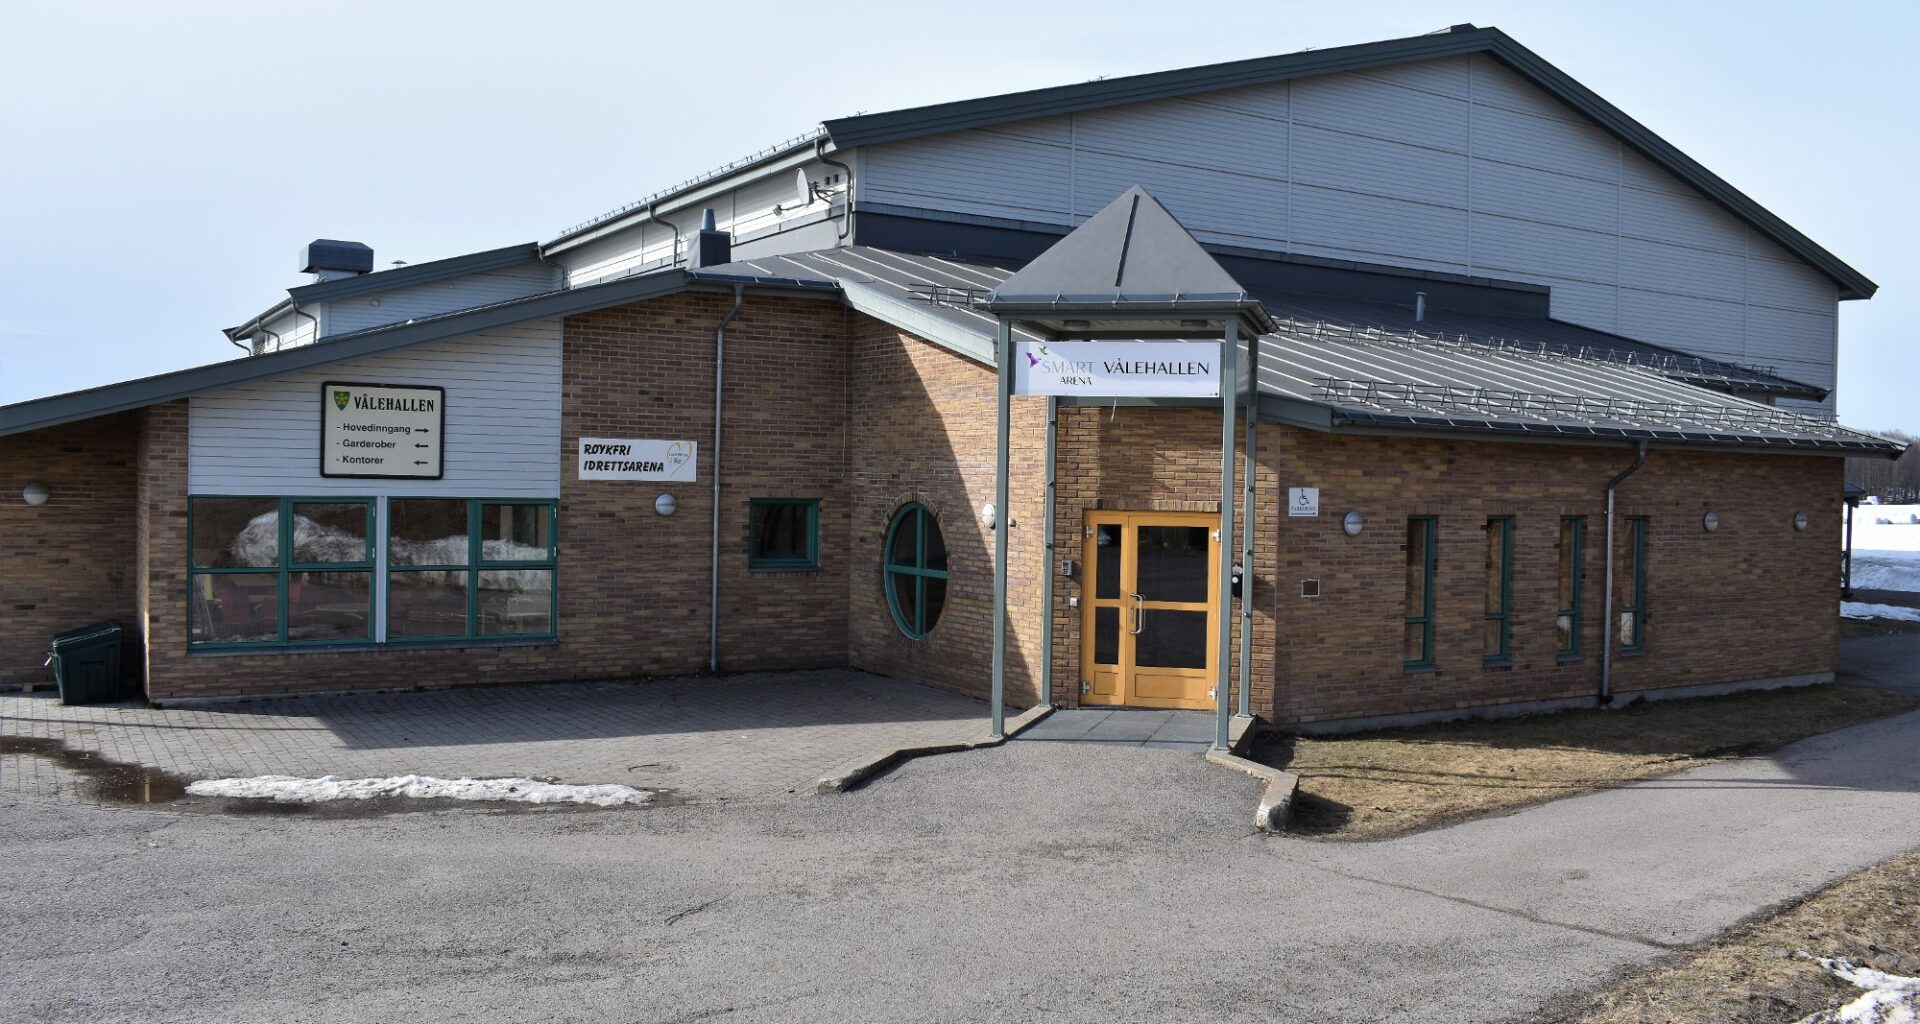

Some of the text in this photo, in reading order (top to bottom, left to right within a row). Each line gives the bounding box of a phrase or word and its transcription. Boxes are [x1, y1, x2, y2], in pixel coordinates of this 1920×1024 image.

[1041, 357, 1209, 375] SMART VÅLEHALLEN
[1060, 376, 1092, 385] ARENA
[354, 393, 434, 412] VÅLEHALLEN
[343, 423, 411, 435] Hovedinngang
[342, 439, 397, 449] Garderober
[583, 444, 631, 456] RØYKFRI
[342, 455, 384, 465] Kontorer
[583, 460, 664, 472] IDRETTSARENA
